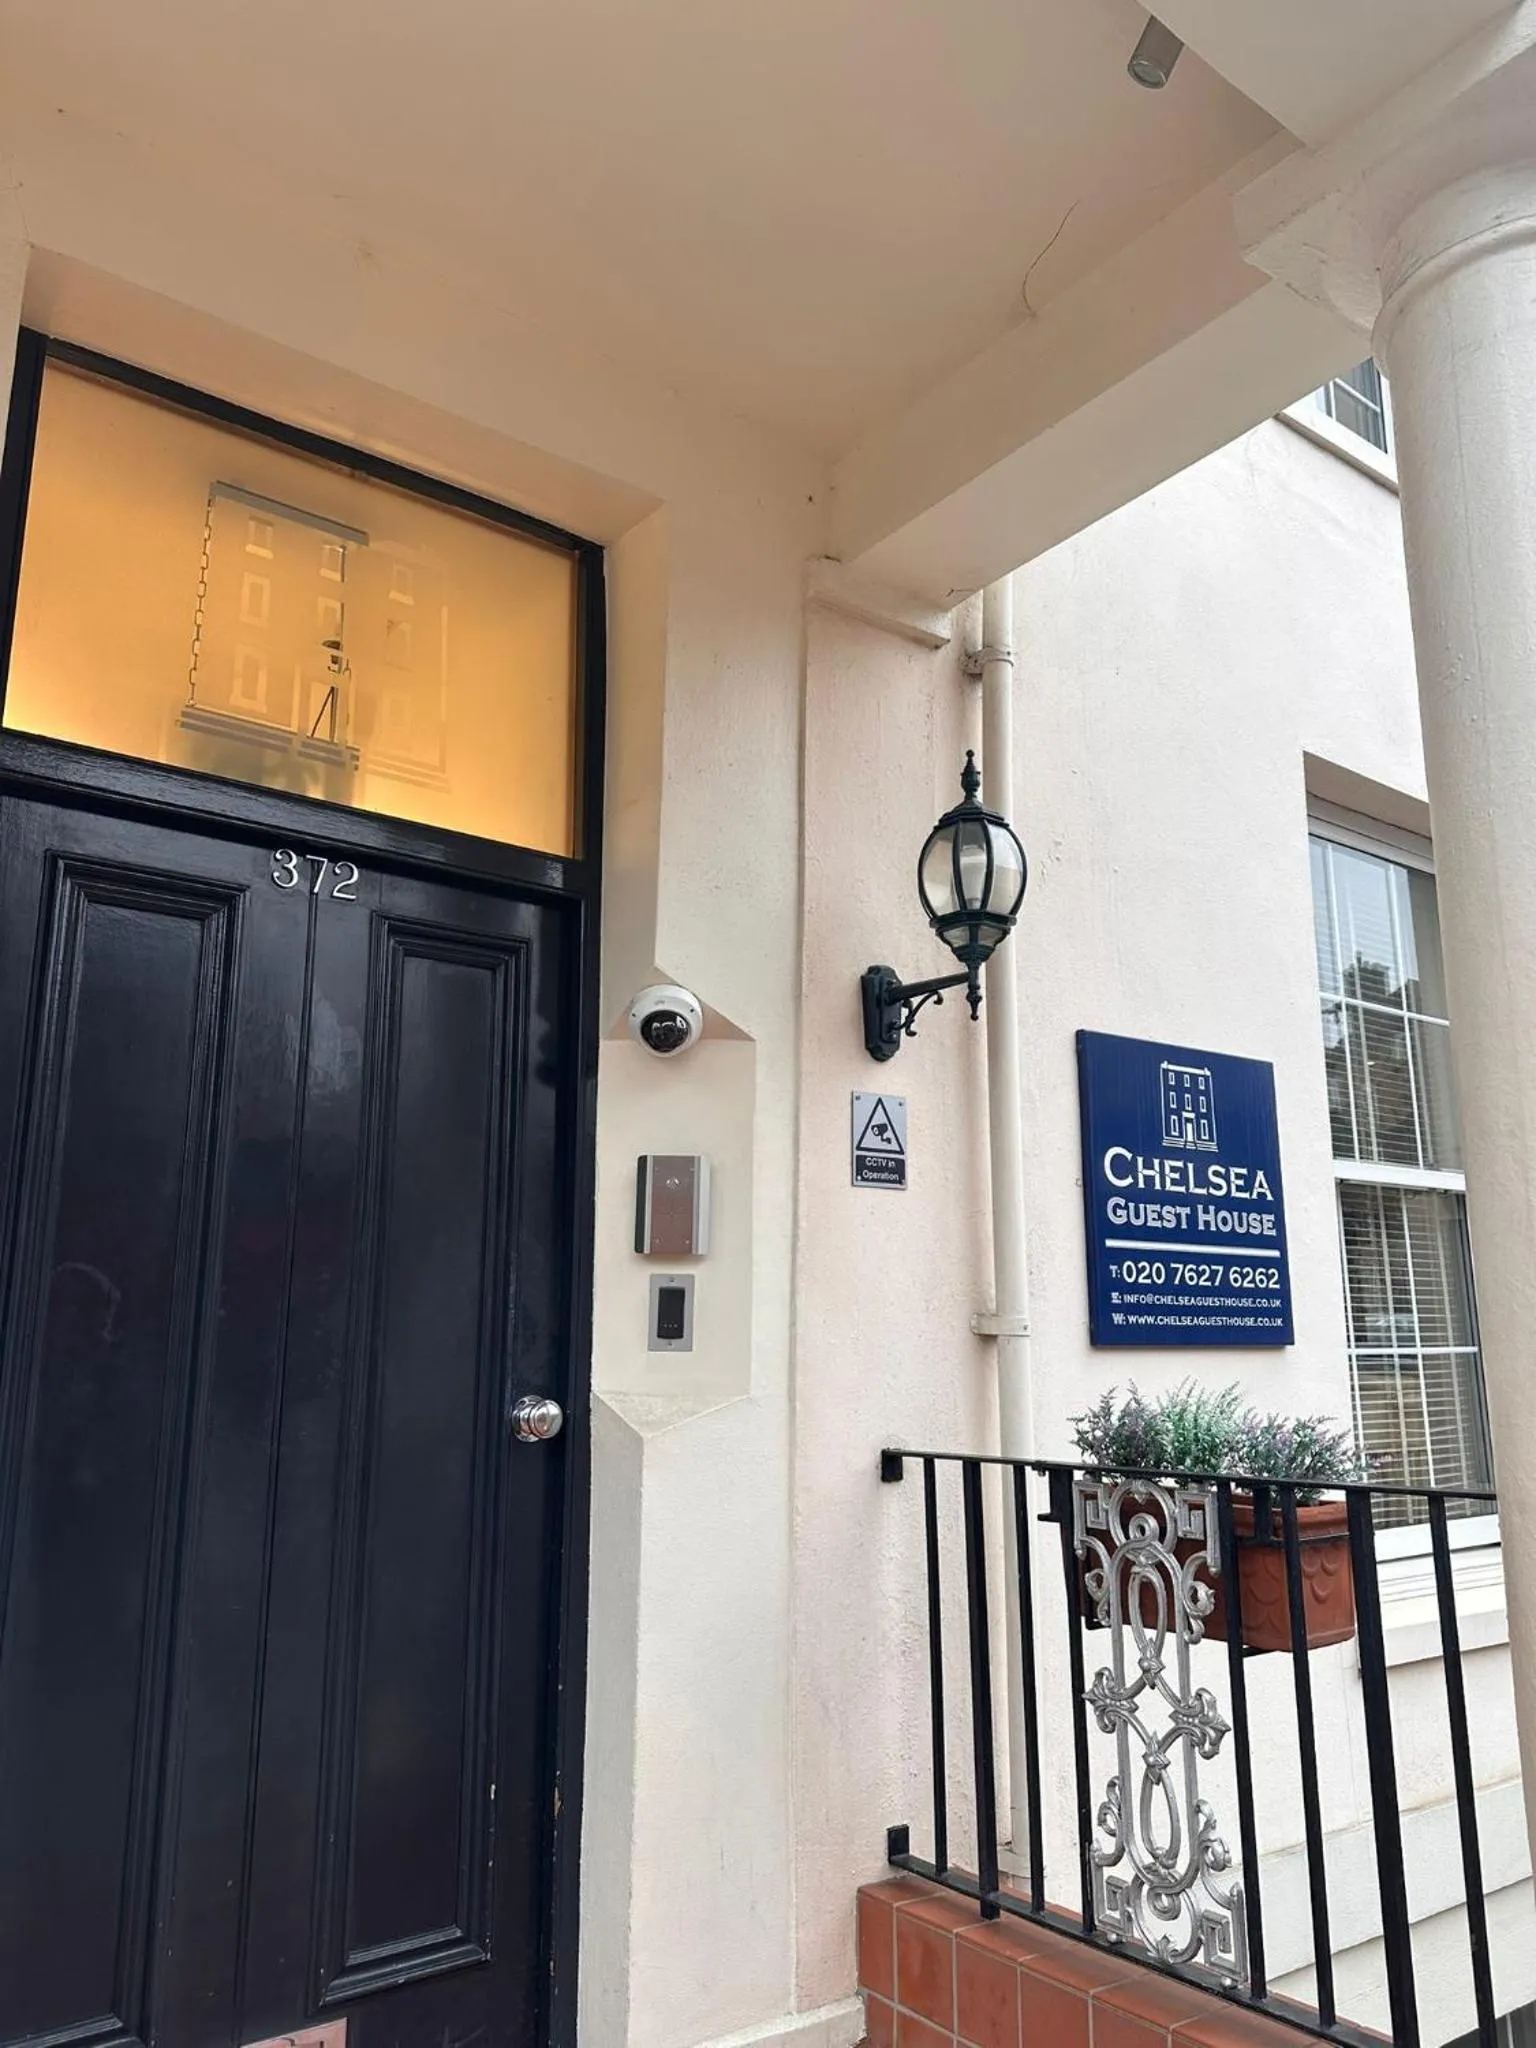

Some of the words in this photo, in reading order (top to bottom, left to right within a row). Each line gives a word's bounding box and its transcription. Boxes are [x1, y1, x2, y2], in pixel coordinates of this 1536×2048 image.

[272, 848, 359, 900] 372
[862, 1169, 899, 1181] Operation
[865, 1157, 887, 1168] CCTV
[1103, 1146, 1274, 1201] CHELSEA
[1106, 1196, 1190, 1230] GUEST
[1198, 1205, 1277, 1236] HOUSE
[1170, 1262, 1224, 1287] 7627
[1229, 1266, 1280, 1289] 6262
